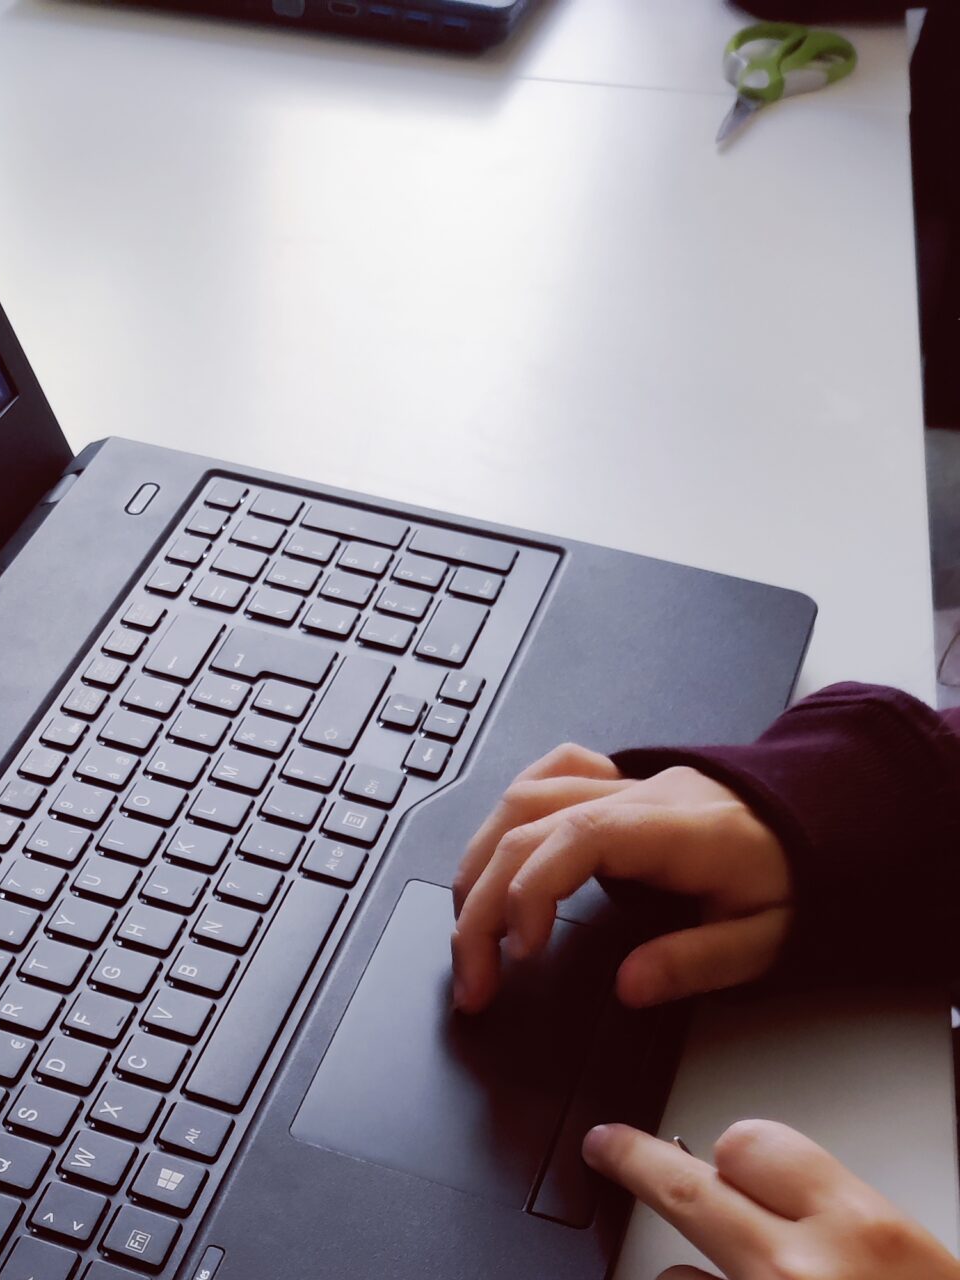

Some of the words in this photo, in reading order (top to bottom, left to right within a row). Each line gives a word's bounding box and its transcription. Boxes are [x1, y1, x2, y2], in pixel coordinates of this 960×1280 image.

[154, 760, 170, 773] P
[219, 765, 239, 778] M
[132, 795, 151, 807] O
[197, 807, 217, 816] L
[174, 840, 196, 854] K
[82, 873, 102, 887] U
[153, 883, 169, 895] J
[55, 914, 77, 928] Y
[202, 920, 223, 934] N
[125, 922, 146, 938] H
[29, 958, 49, 971] T
[177, 964, 198, 978] B
[101, 965, 122, 980] G
[1, 1002, 24, 1018] R
[152, 1006, 174, 1022] V
[74, 1011, 92, 1026] F
[45, 1058, 67, 1073] D
[127, 1054, 148, 1070] C
[17, 1106, 39, 1122] S
[99, 1100, 124, 1119] X
[184, 1127, 202, 1145] Alt
[70, 1147, 96, 1169] W
[129, 1233, 148, 1251] Fn
